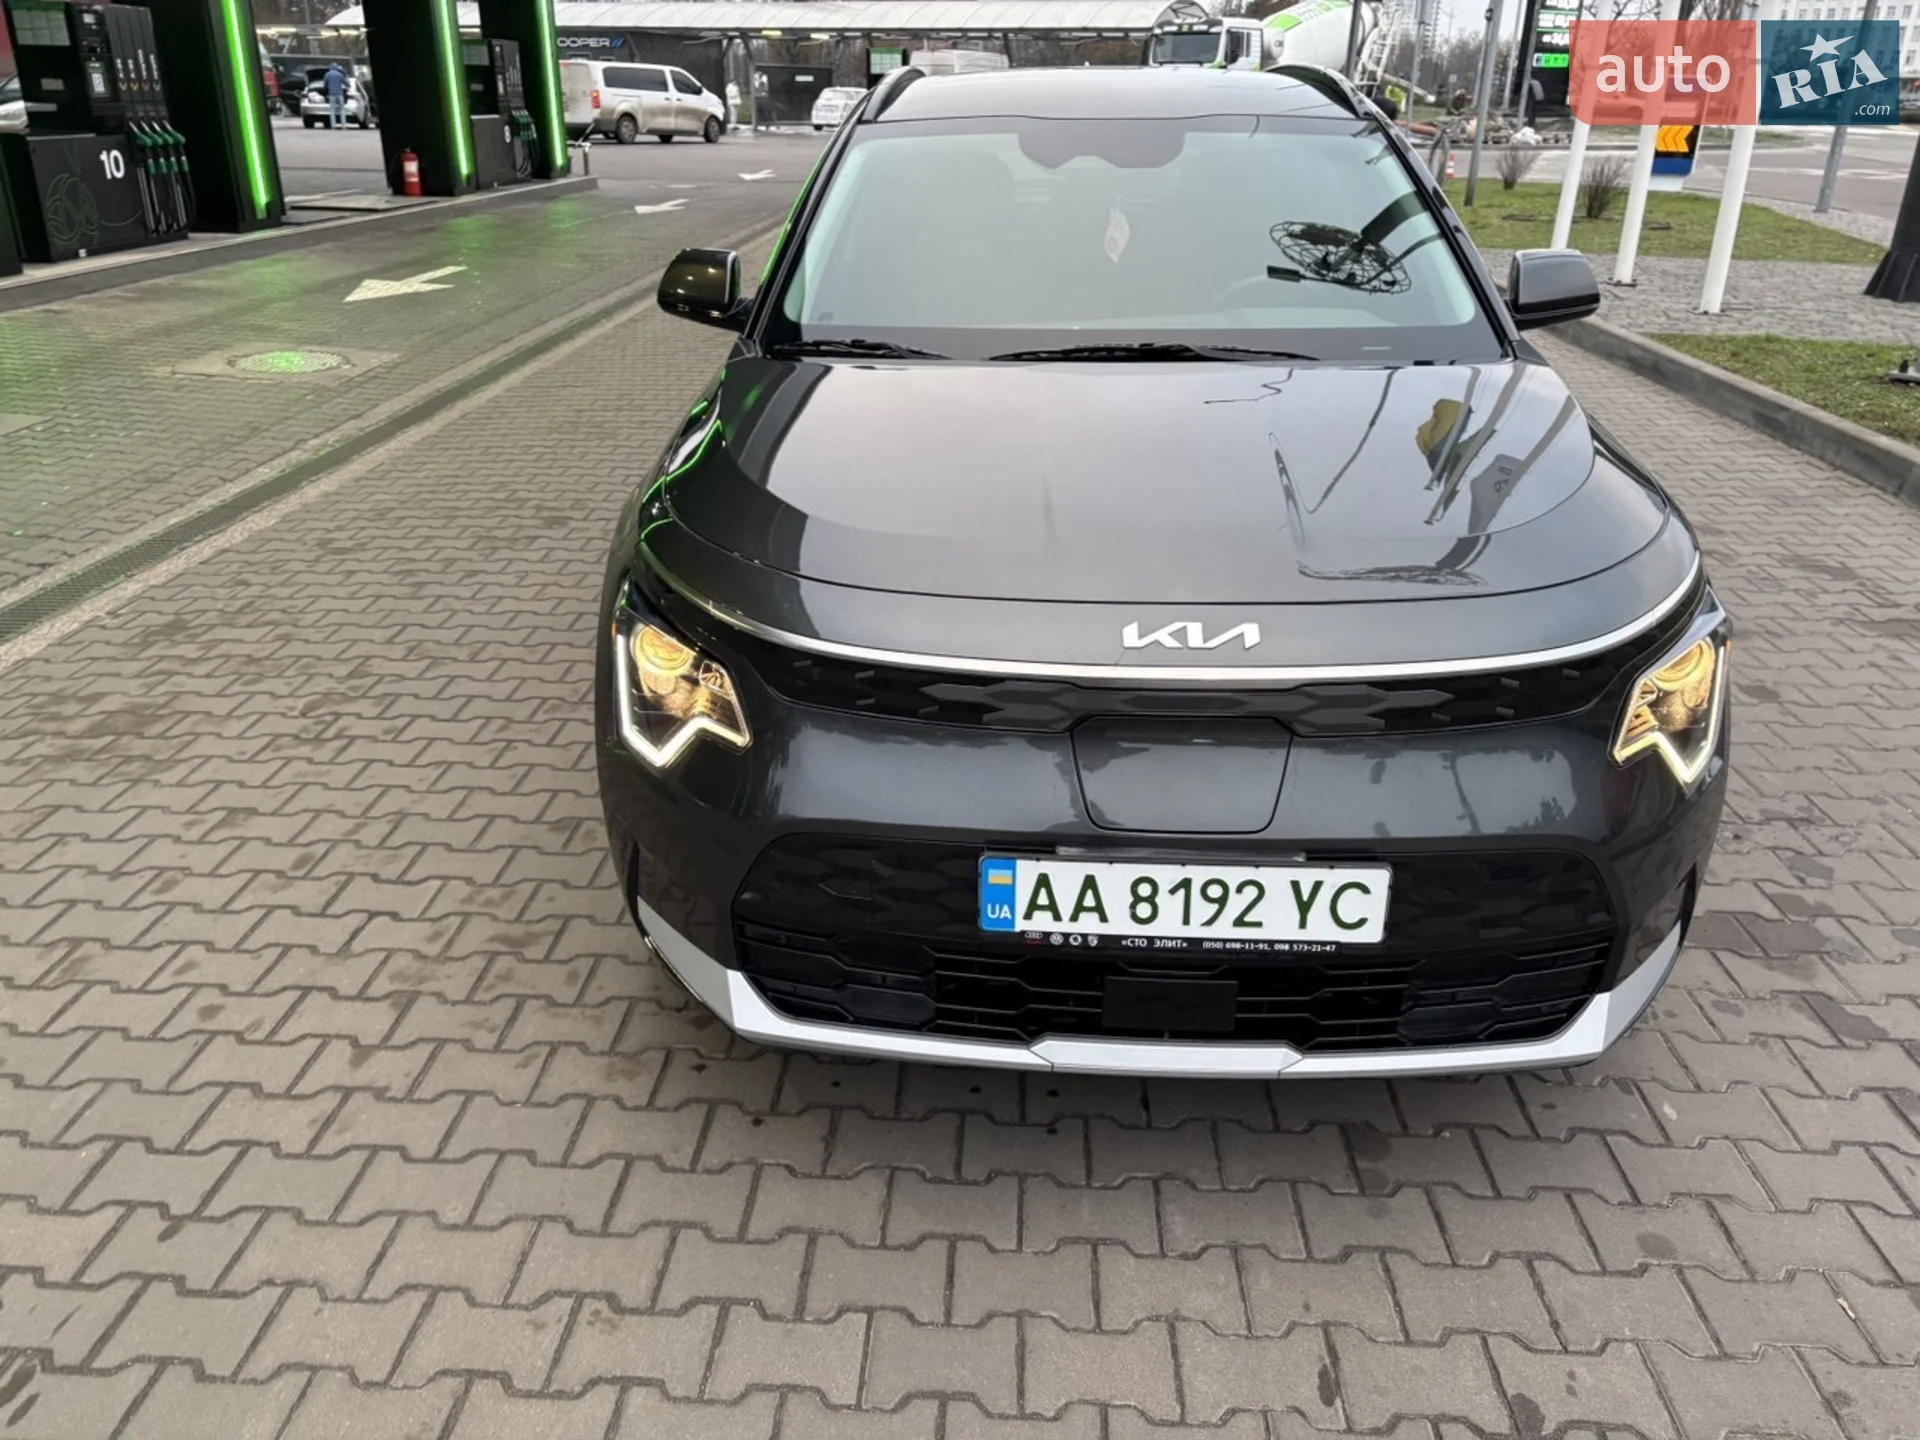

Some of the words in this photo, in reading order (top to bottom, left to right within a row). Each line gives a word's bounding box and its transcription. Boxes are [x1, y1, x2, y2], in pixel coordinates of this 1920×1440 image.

[99, 149, 125, 179] 10
[986, 904, 1012, 920] UA
[1023, 872, 1109, 923] AA
[1129, 875, 1266, 927] 8192
[1289, 879, 1372, 931] YC
